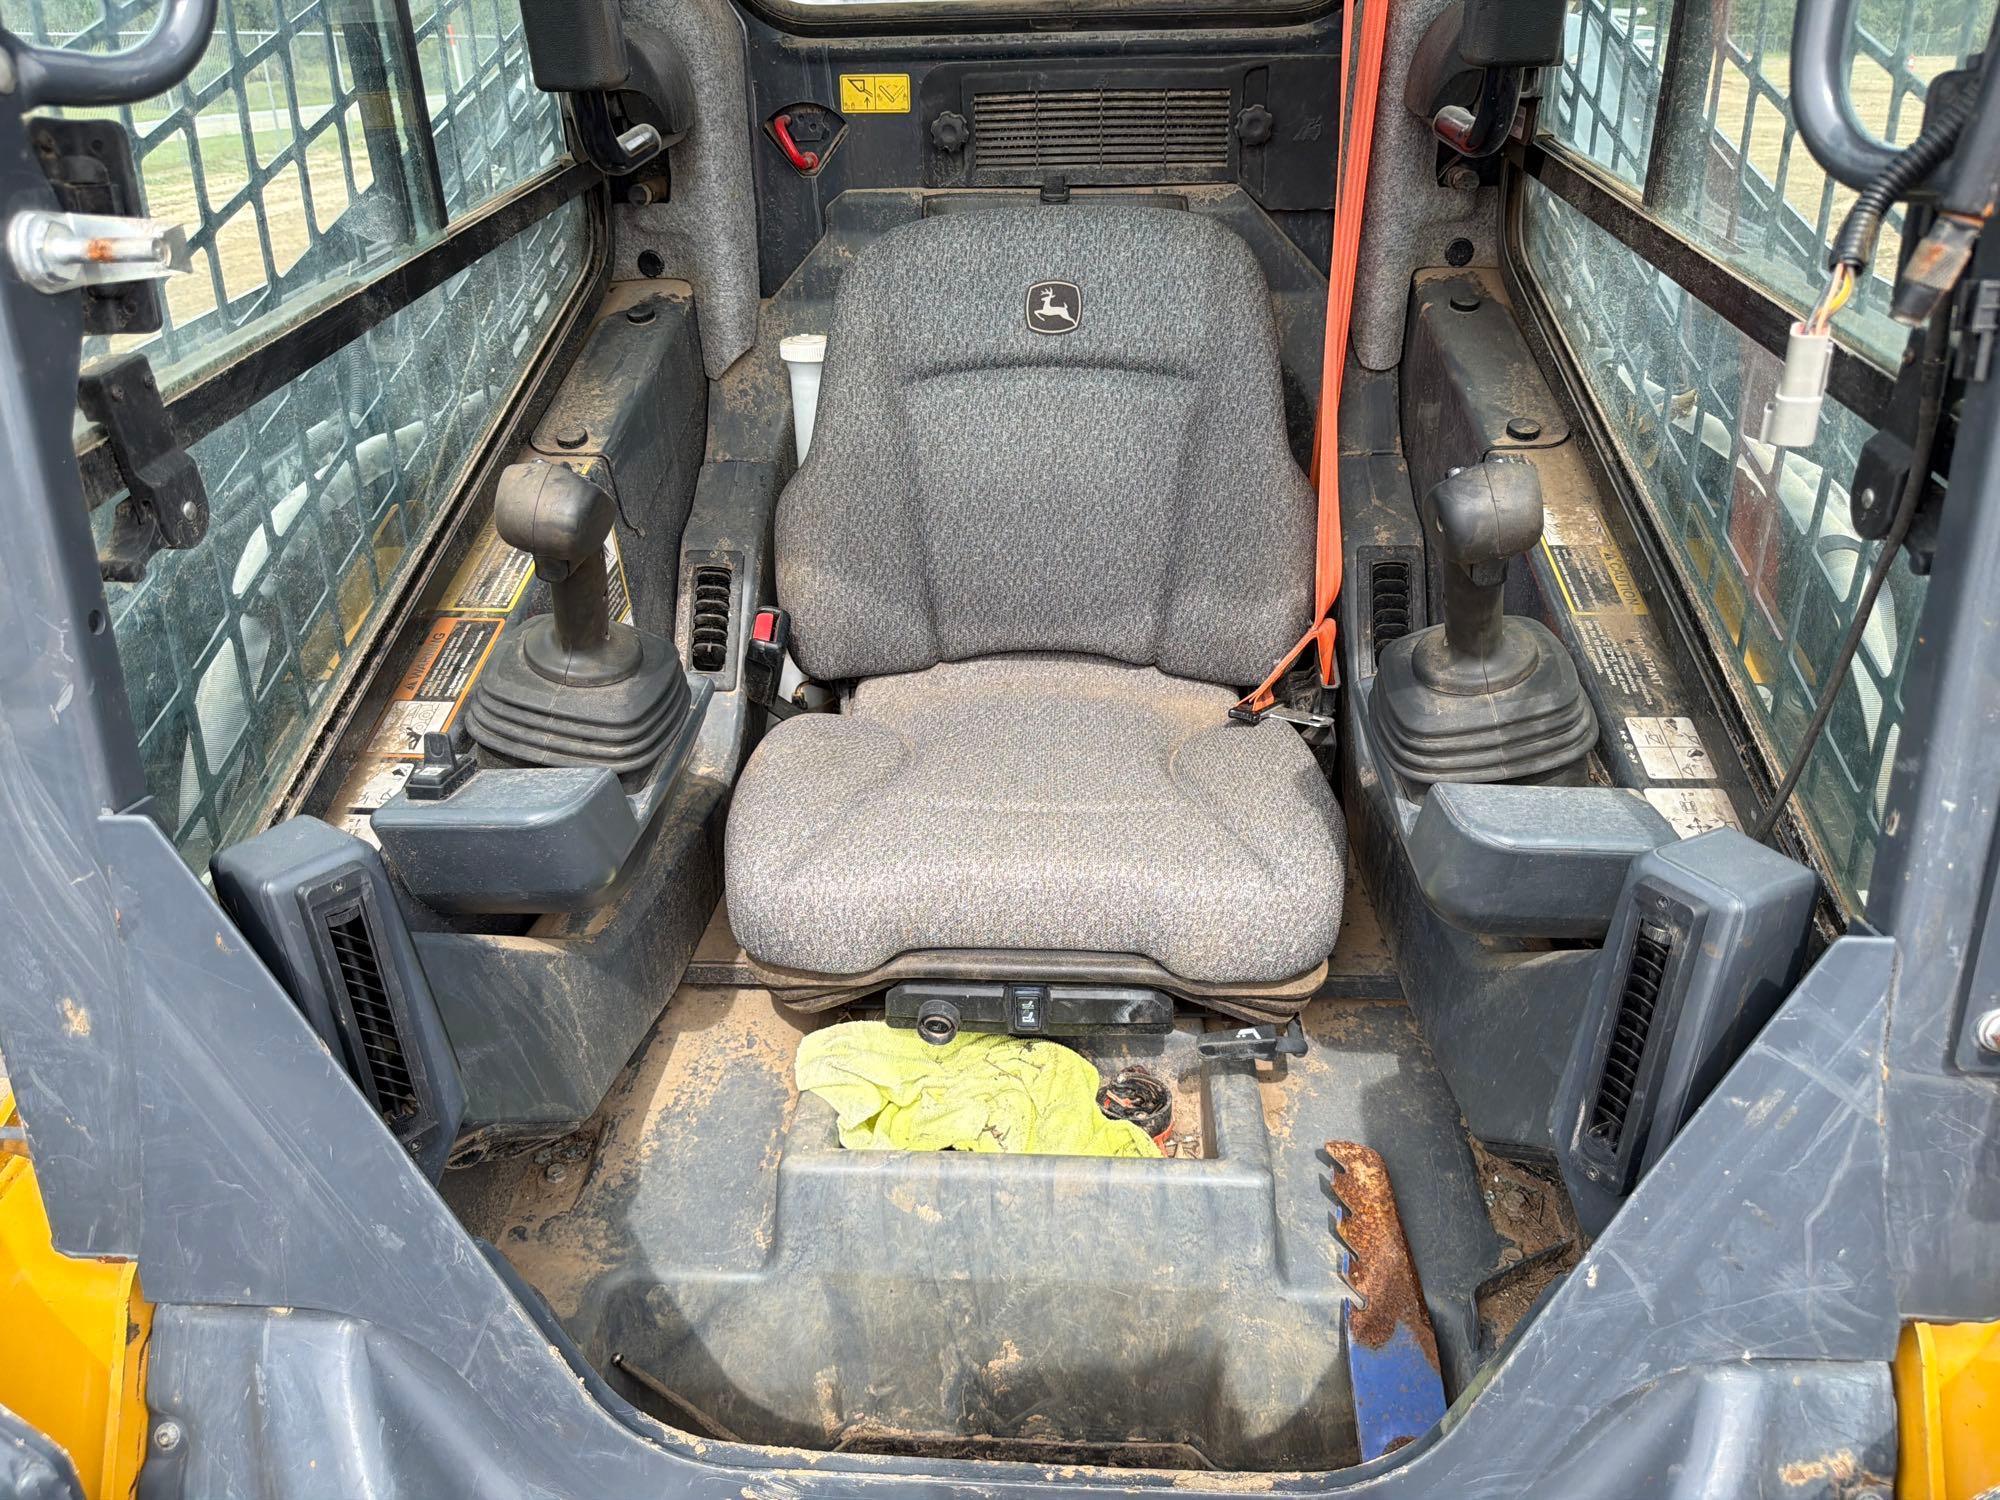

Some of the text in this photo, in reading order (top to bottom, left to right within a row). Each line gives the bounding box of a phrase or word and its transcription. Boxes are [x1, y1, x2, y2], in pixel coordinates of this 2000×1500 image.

[1609, 561, 1640, 606] CAUTION
[412, 632, 446, 677] WARNING
[1630, 632, 1664, 686] IMPORTANT
